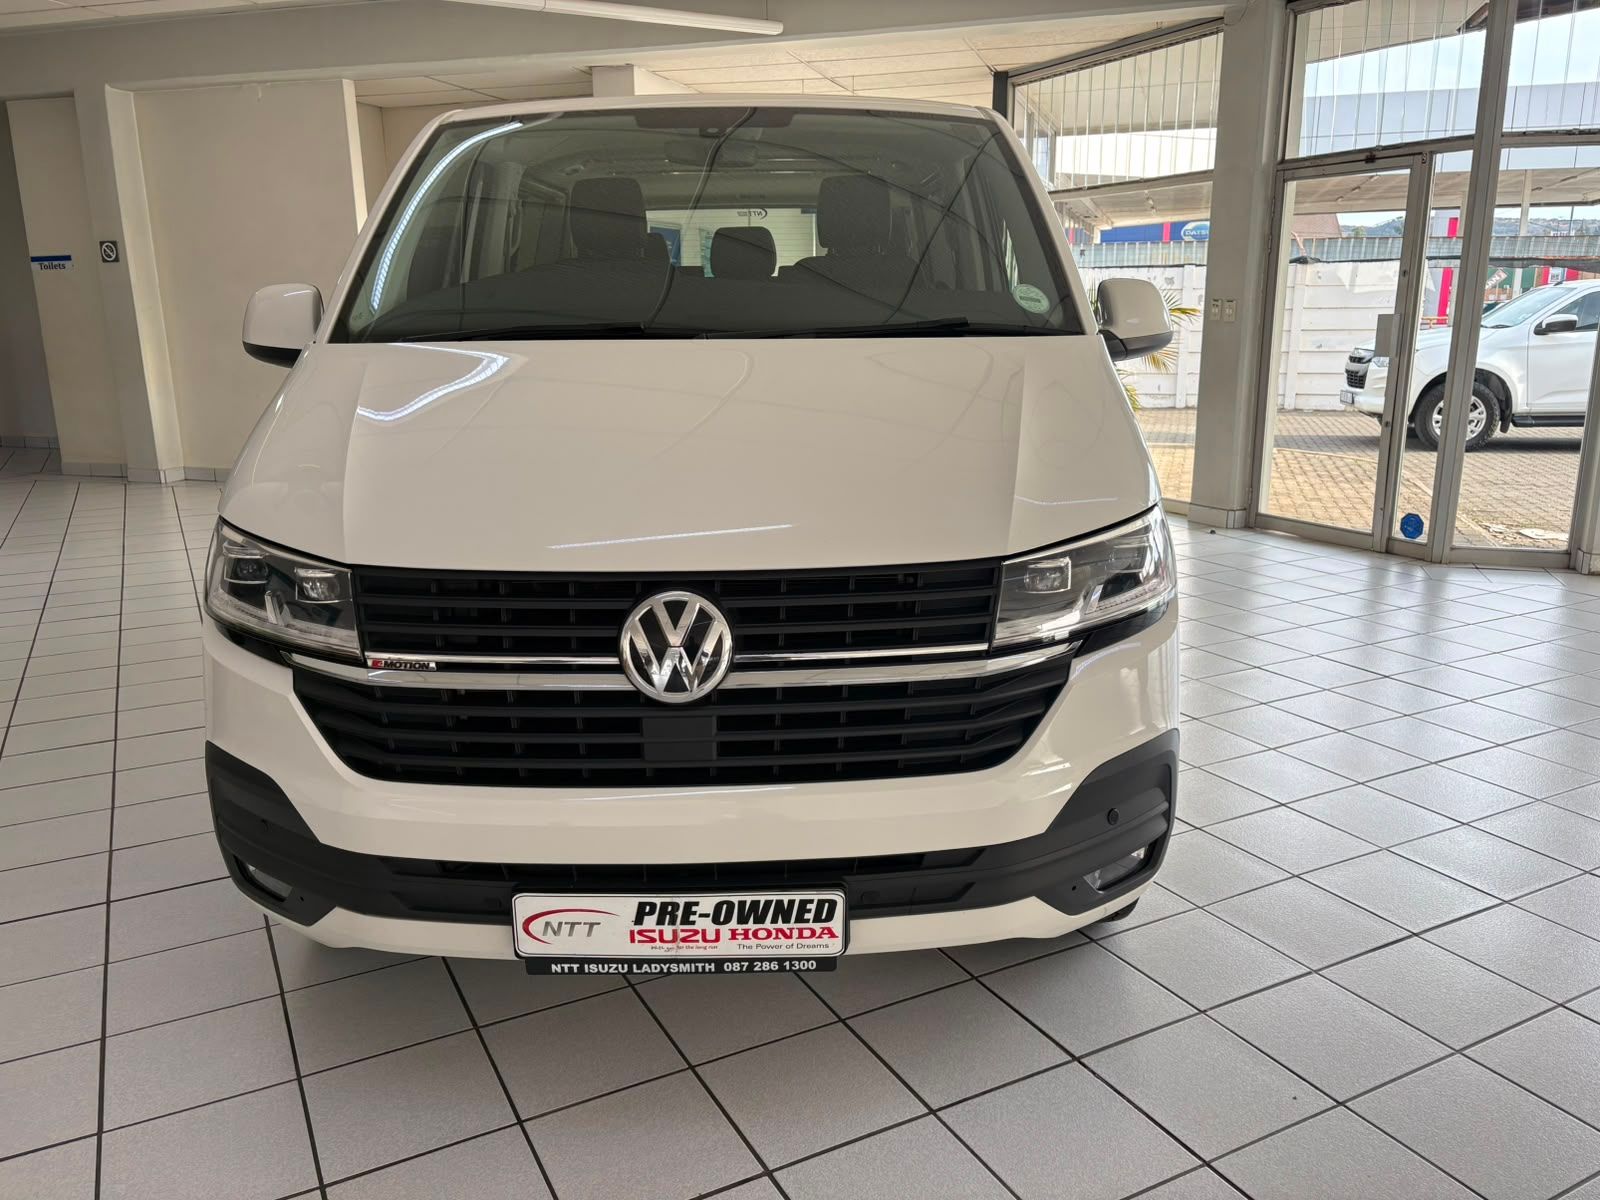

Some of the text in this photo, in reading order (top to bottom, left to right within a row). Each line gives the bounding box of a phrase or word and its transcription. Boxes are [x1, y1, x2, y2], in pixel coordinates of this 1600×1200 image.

[39, 262, 66, 271] Toilets
[633, 899, 838, 926] PRE-OWNED
[542, 921, 601, 938] NTT
[629, 926, 839, 944] ISUZU HONDA
[785, 942, 794, 950] of
[796, 942, 830, 950] Dreams
[551, 960, 817, 974] NTT ISUZU LADYSMITH 087 286 1300
